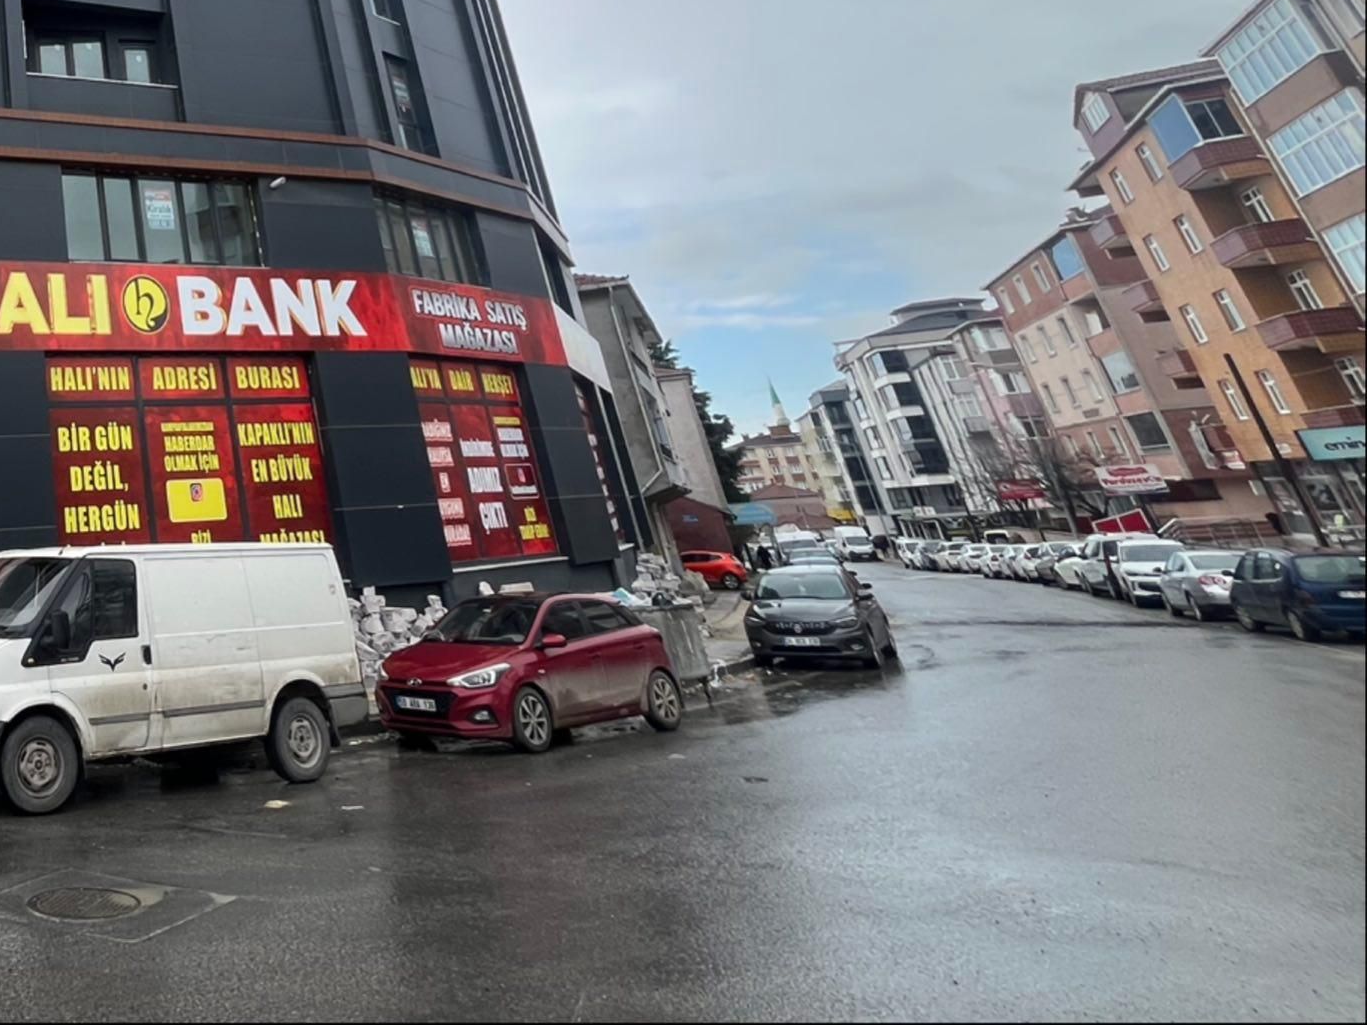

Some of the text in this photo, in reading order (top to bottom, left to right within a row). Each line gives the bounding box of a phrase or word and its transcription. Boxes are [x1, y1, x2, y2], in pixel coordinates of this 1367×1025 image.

[177, 275, 368, 337] BANK
[412, 289, 527, 331] FABRİKA SATIŞ
[439, 321, 518, 354] MAĞAZASI
[50, 363, 301, 392] HALI'NIN ADRESİ BURASI
[57, 421, 133, 453] BİR GÜN
[164, 435, 216, 452] HABERDAR
[237, 422, 315, 447] KAPAKLI'NIN
[69, 460, 129, 492] DEĞİL,
[164, 451, 220, 474] OLMAK İÇİN
[251, 455, 313, 483] EN BÜYÜK
[64, 499, 141, 534] HERGÜN
[272, 494, 303, 519] HALI
